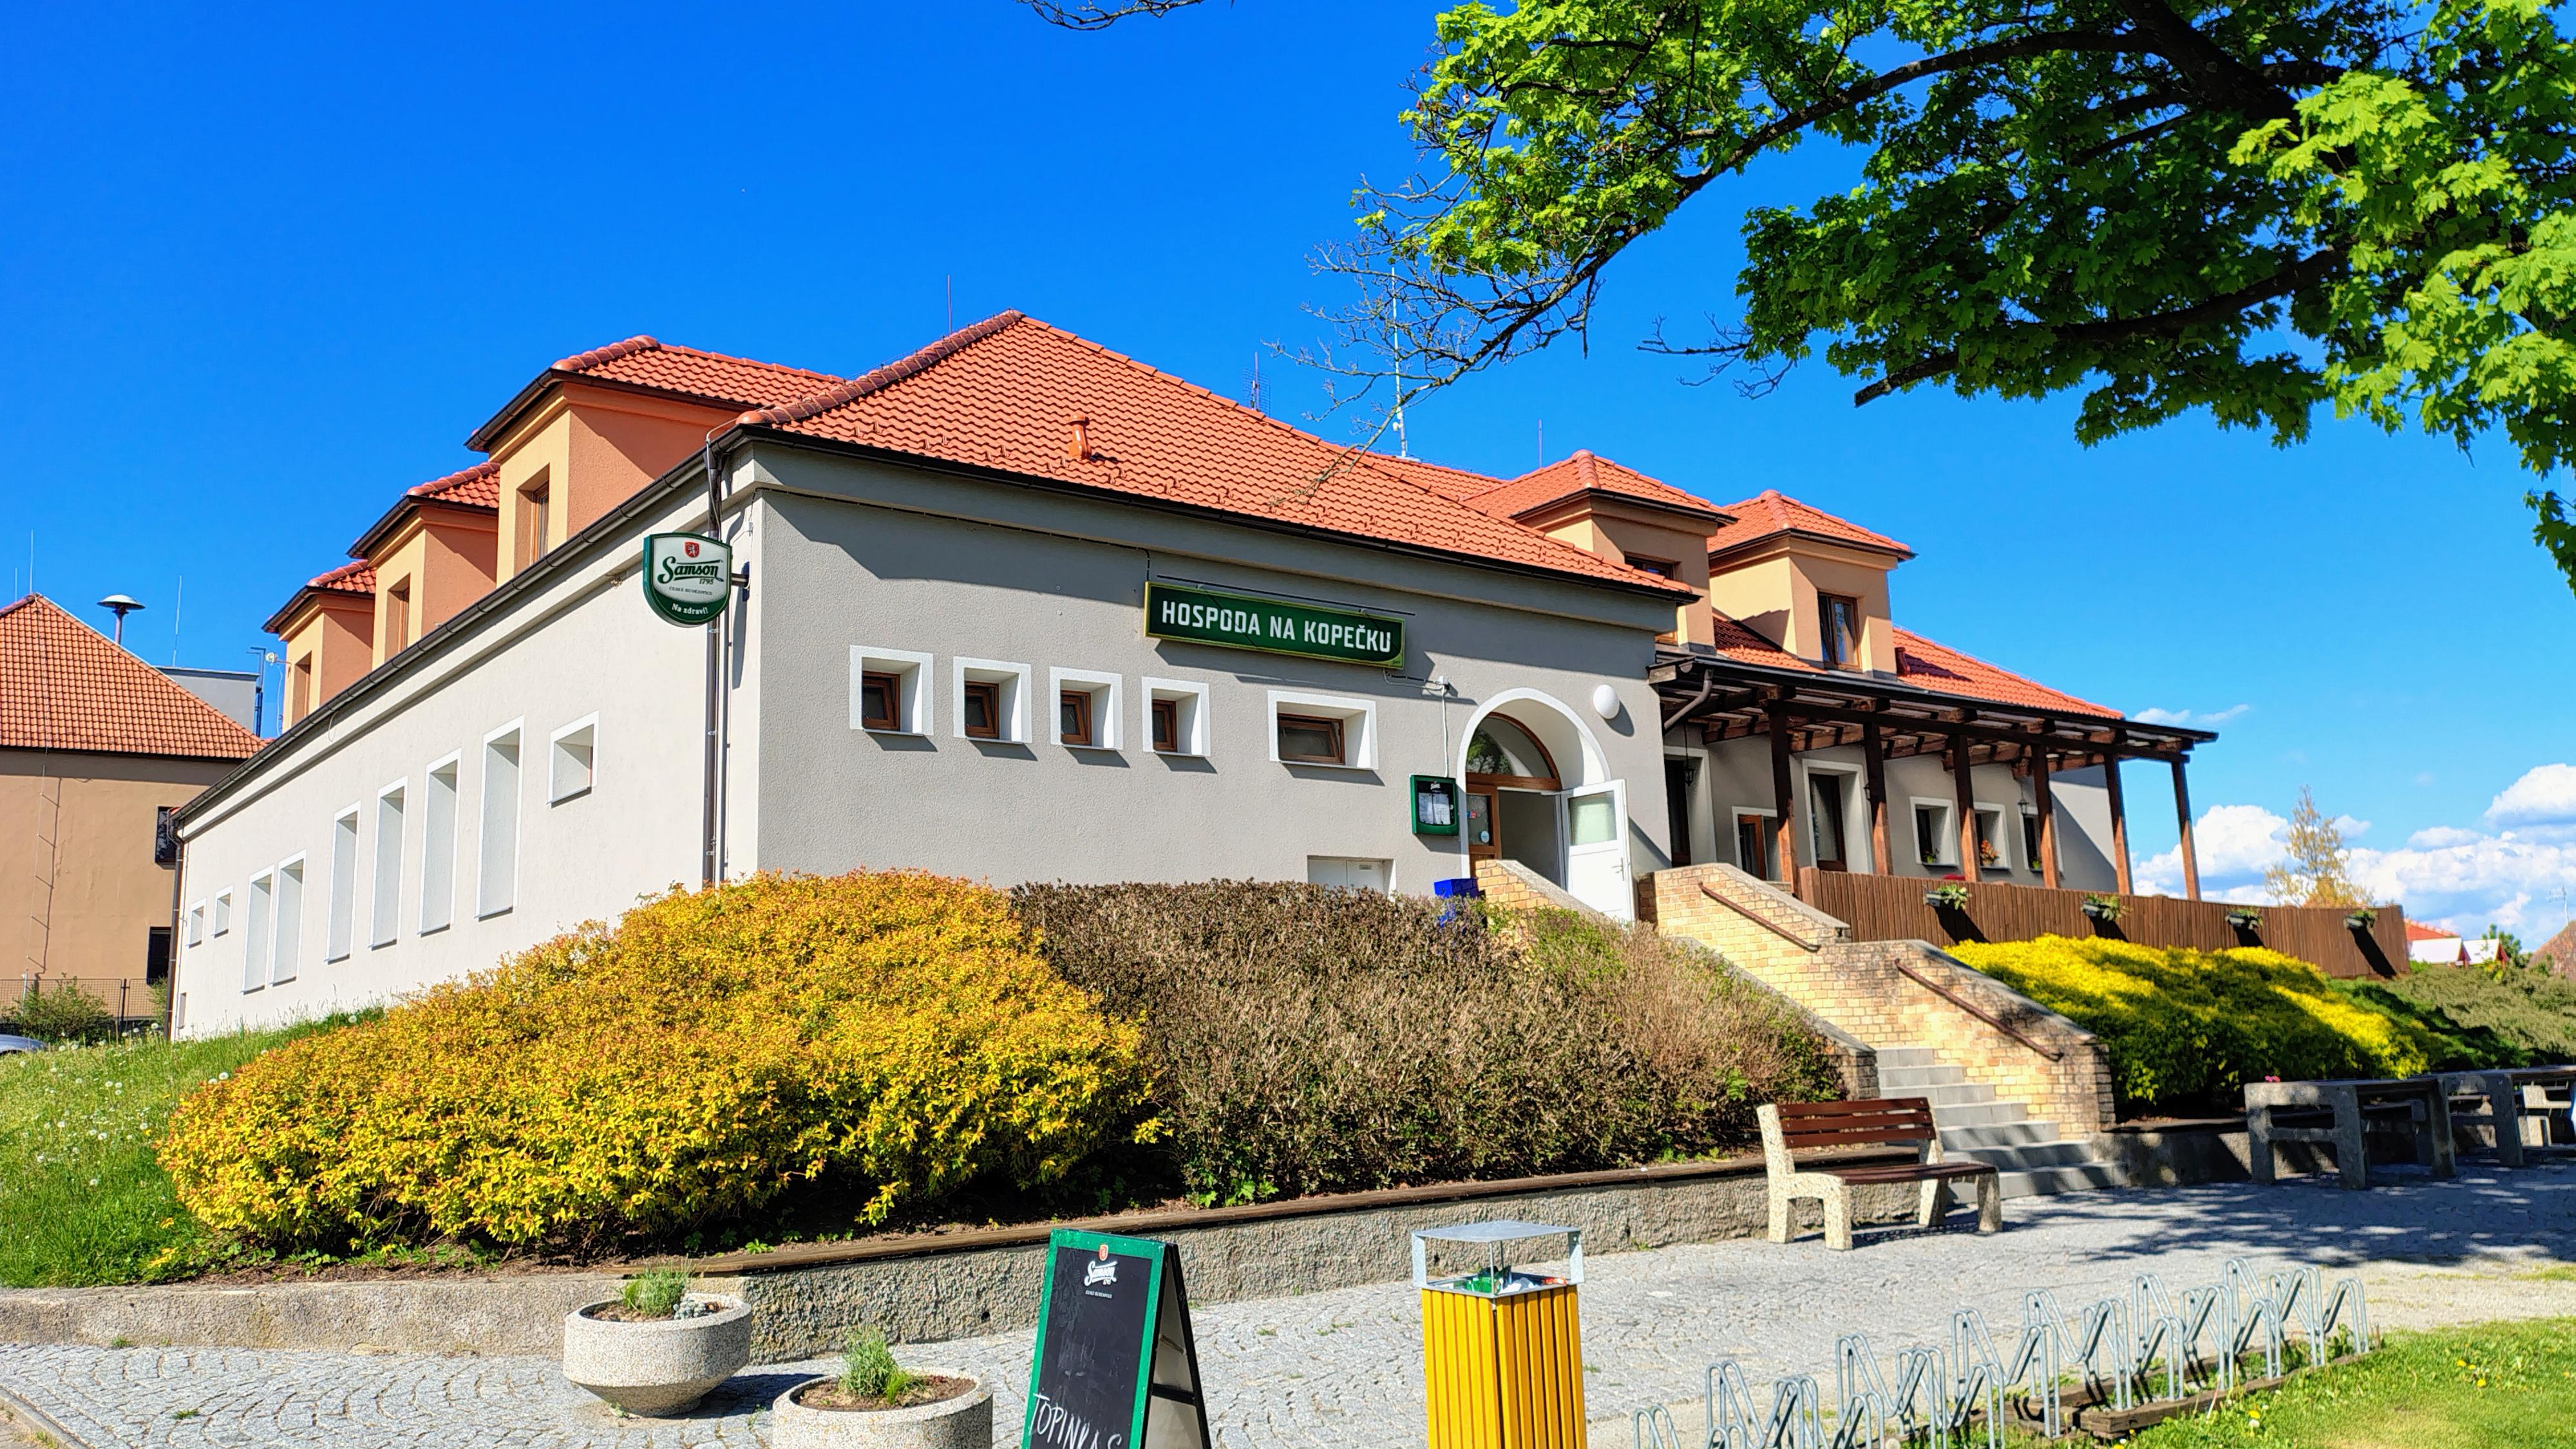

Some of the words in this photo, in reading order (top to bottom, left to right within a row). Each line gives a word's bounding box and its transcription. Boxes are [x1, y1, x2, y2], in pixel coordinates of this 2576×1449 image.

[658, 556, 724, 584] Samson
[671, 603, 682, 612] Na
[1162, 600, 1261, 636] HOSPODA
[1269, 616, 1296, 640] NA
[1304, 620, 1391, 653] KOPEČKU
